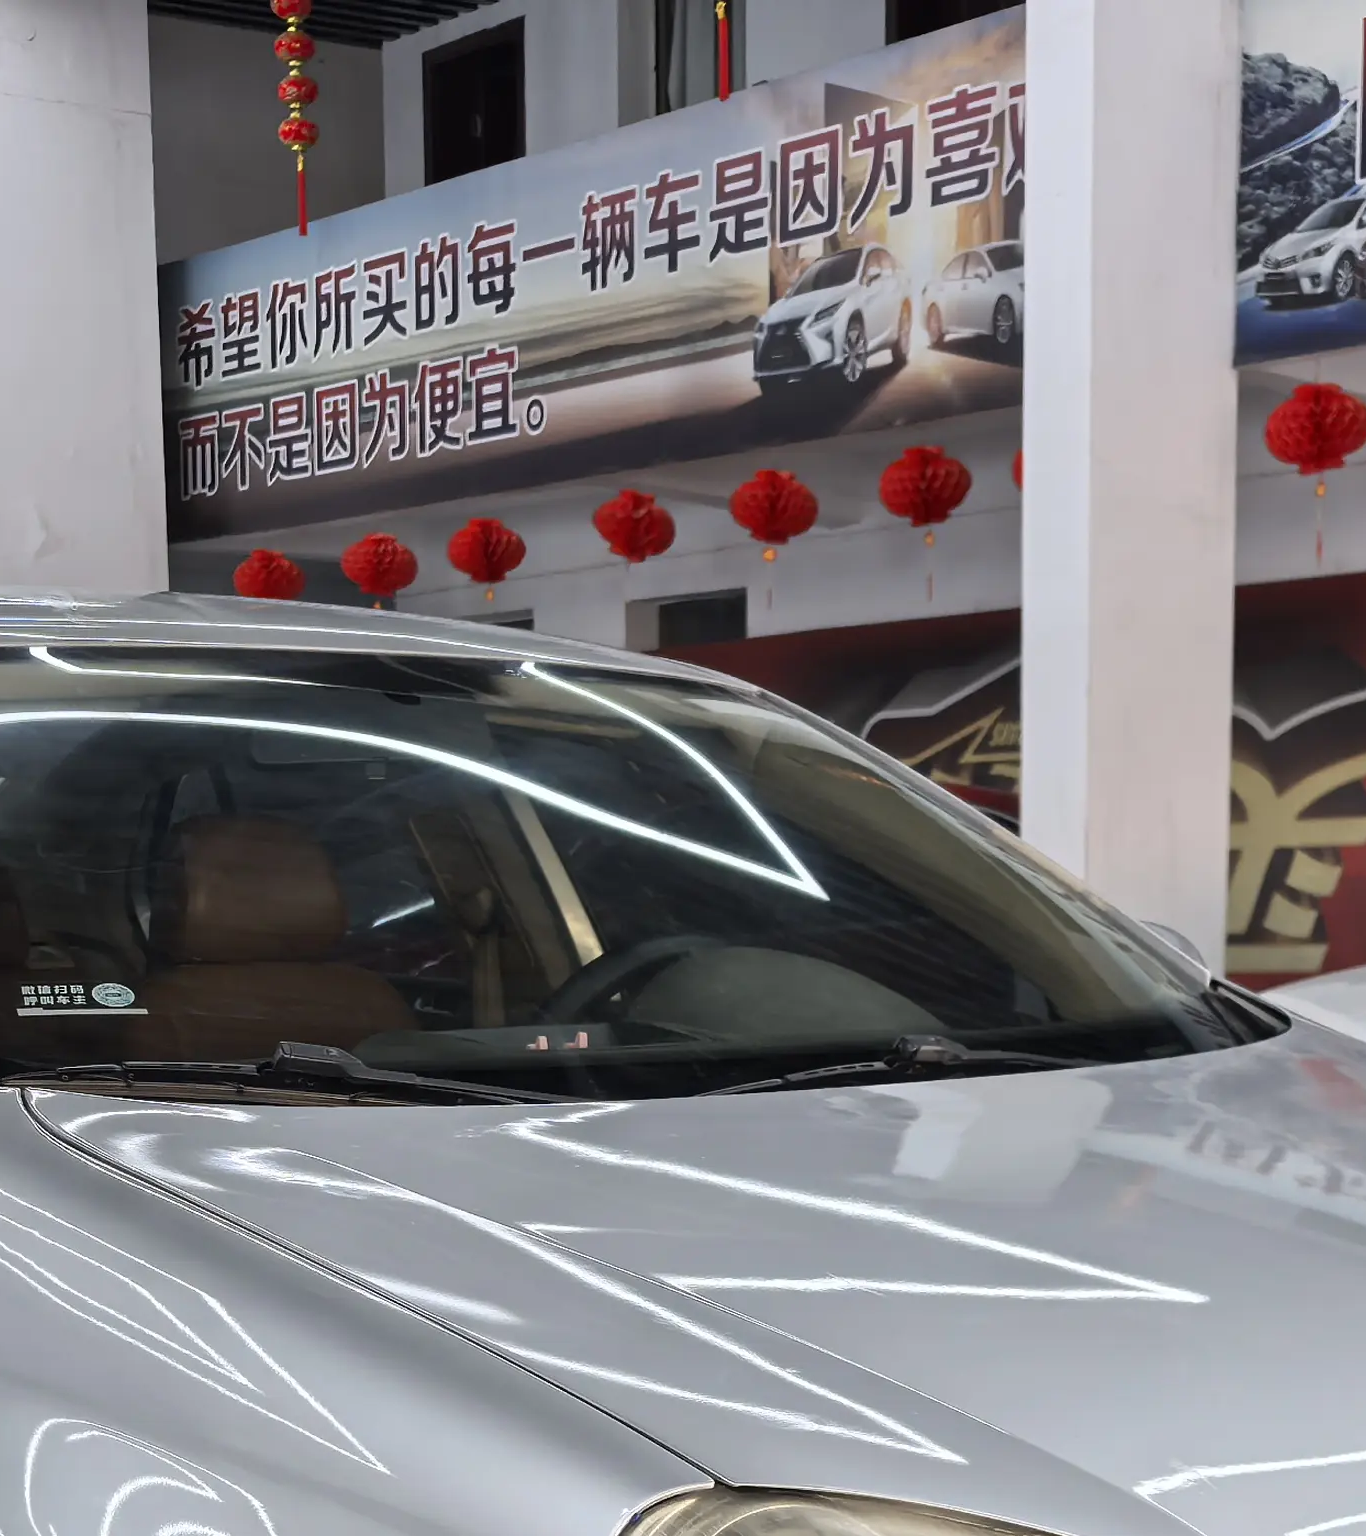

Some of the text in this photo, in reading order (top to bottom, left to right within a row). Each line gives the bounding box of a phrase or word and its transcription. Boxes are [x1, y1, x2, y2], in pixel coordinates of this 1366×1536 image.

[179, 345, 546, 500] 而不是因为便宜。
[23, 995, 87, 1006] 呼叫车主
